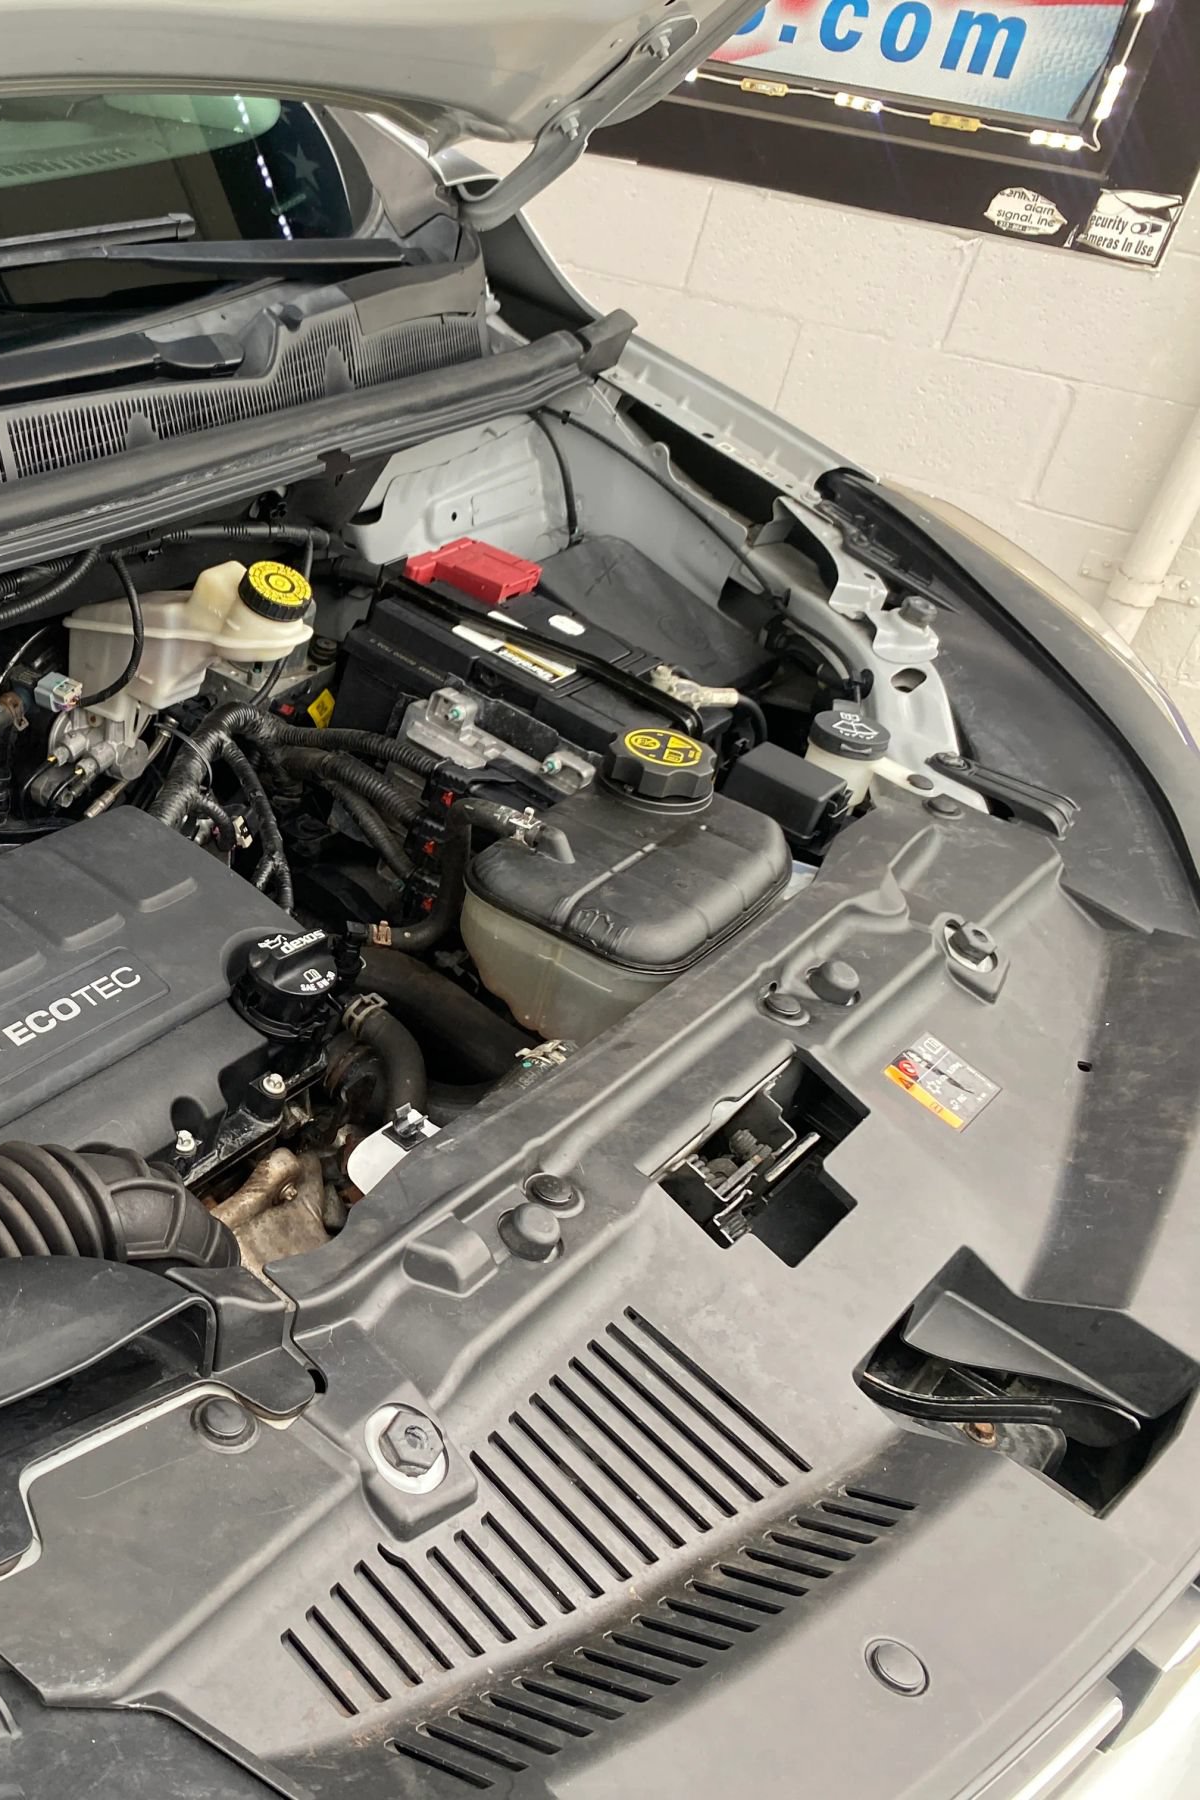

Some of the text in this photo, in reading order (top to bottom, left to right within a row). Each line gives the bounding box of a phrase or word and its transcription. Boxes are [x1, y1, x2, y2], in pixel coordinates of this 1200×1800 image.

[1121, 237, 1132, 253] In
[1134, 239, 1154, 257] Use
[280, 929, 326, 955] dexos
[2, 966, 142, 1047] ECOTEC
